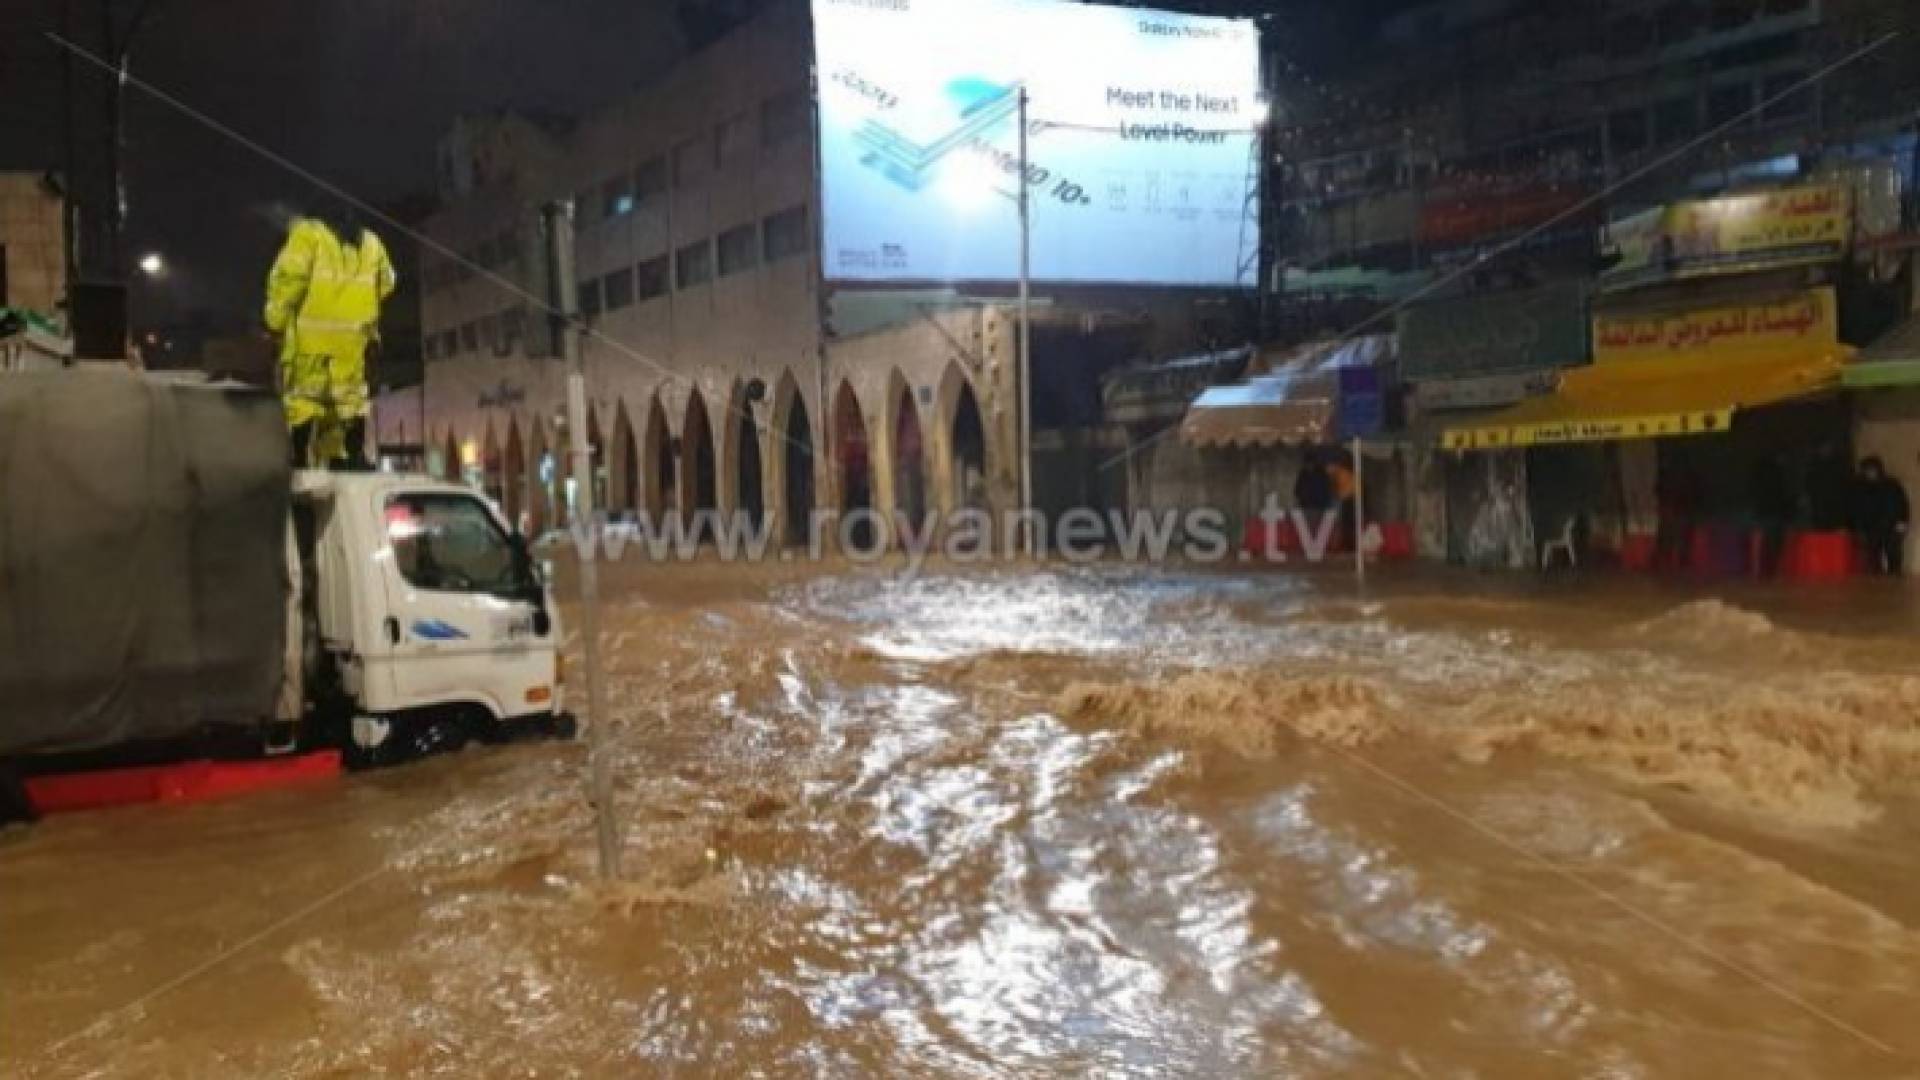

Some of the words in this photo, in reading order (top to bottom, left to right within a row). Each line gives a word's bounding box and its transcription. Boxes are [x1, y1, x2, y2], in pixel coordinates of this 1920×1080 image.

[1106, 85, 1154, 109] Meet
[1160, 89, 1191, 112] the
[1195, 90, 1238, 114] Next
[1119, 119, 1170, 141] Level
[1172, 121, 1227, 144] Power
